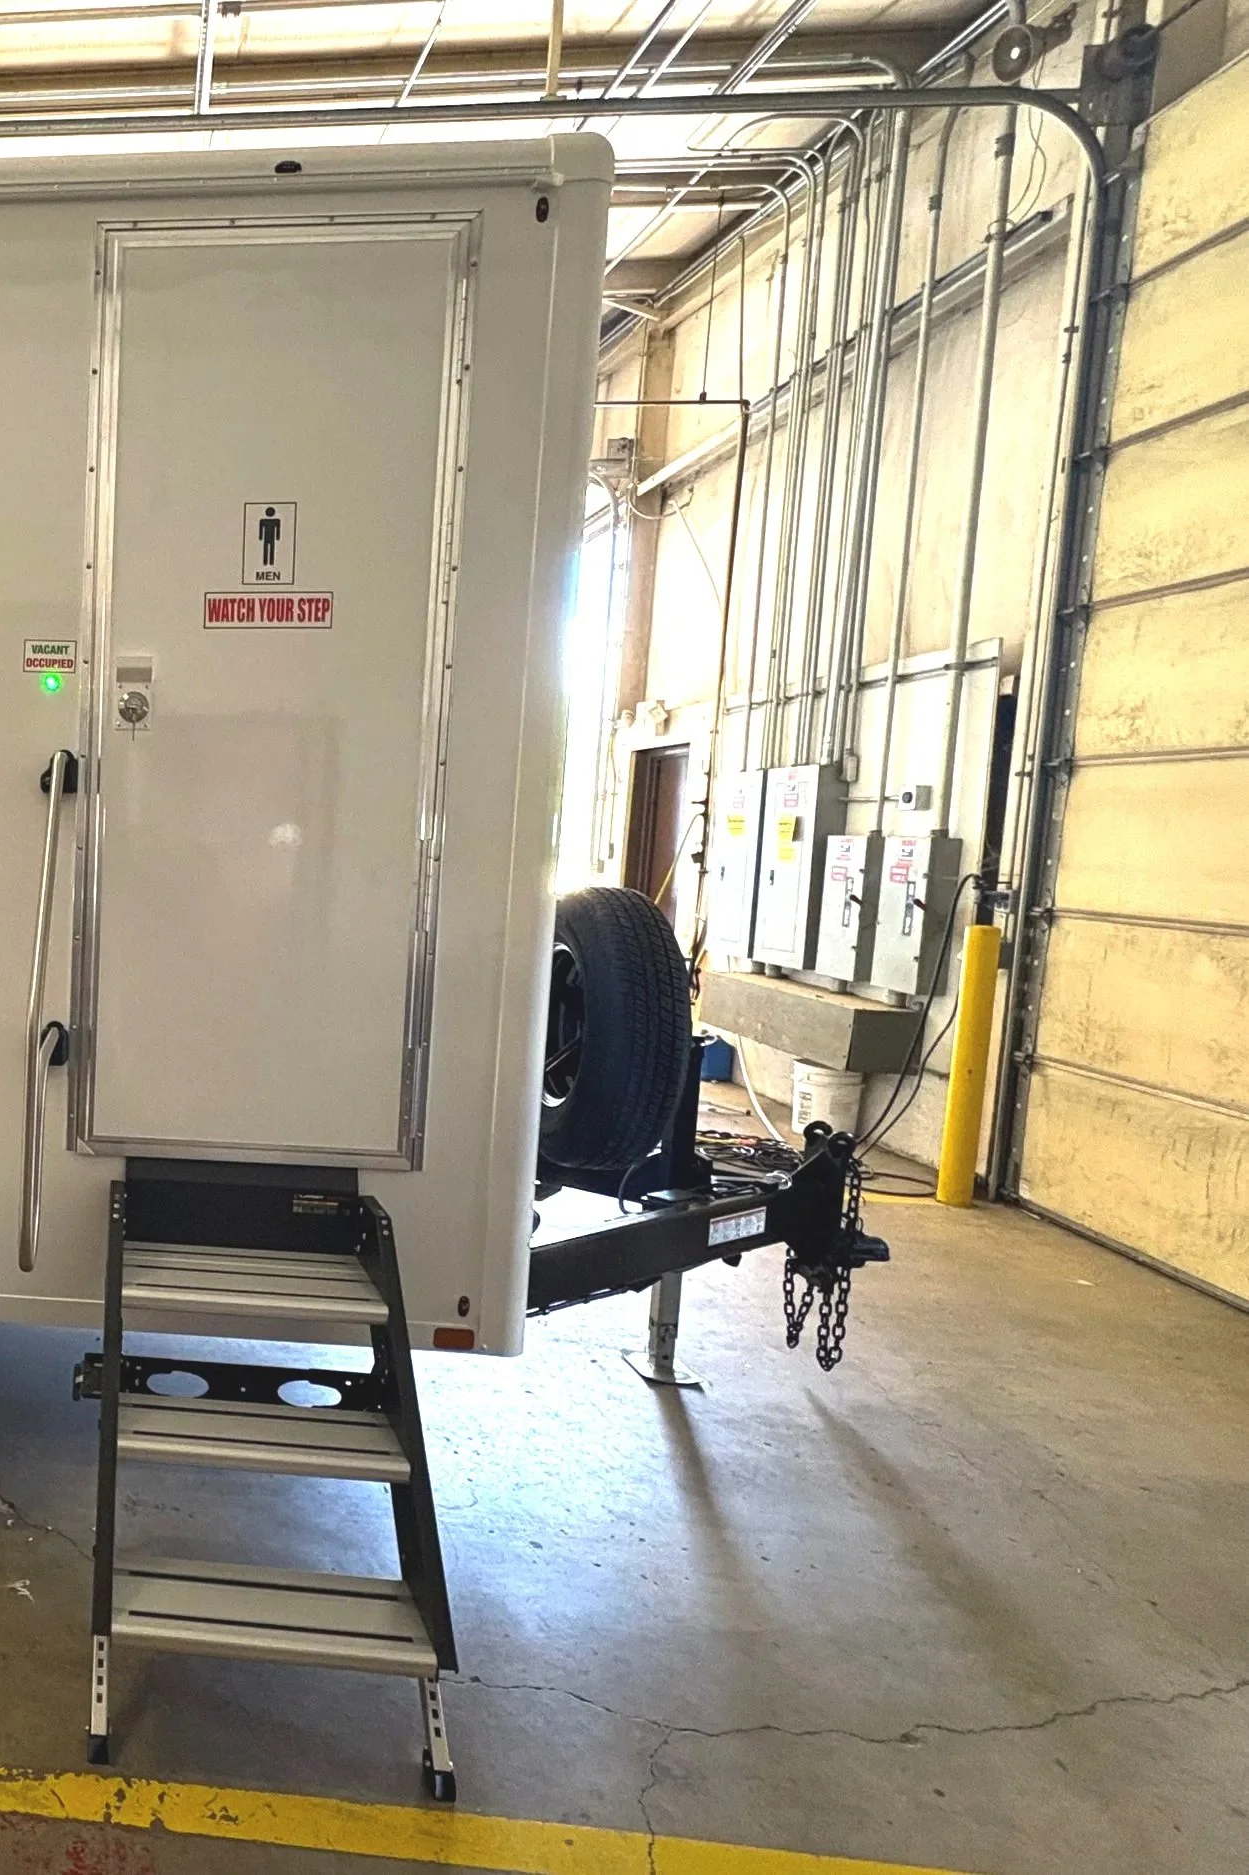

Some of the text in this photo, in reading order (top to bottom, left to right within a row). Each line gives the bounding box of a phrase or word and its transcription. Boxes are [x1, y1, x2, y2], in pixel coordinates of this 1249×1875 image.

[255, 571, 281, 581] MEN
[208, 598, 330, 622] WATCH YOUR STEP
[31, 644, 70, 655] VACANT
[26, 658, 73, 669] OCCUPIED
